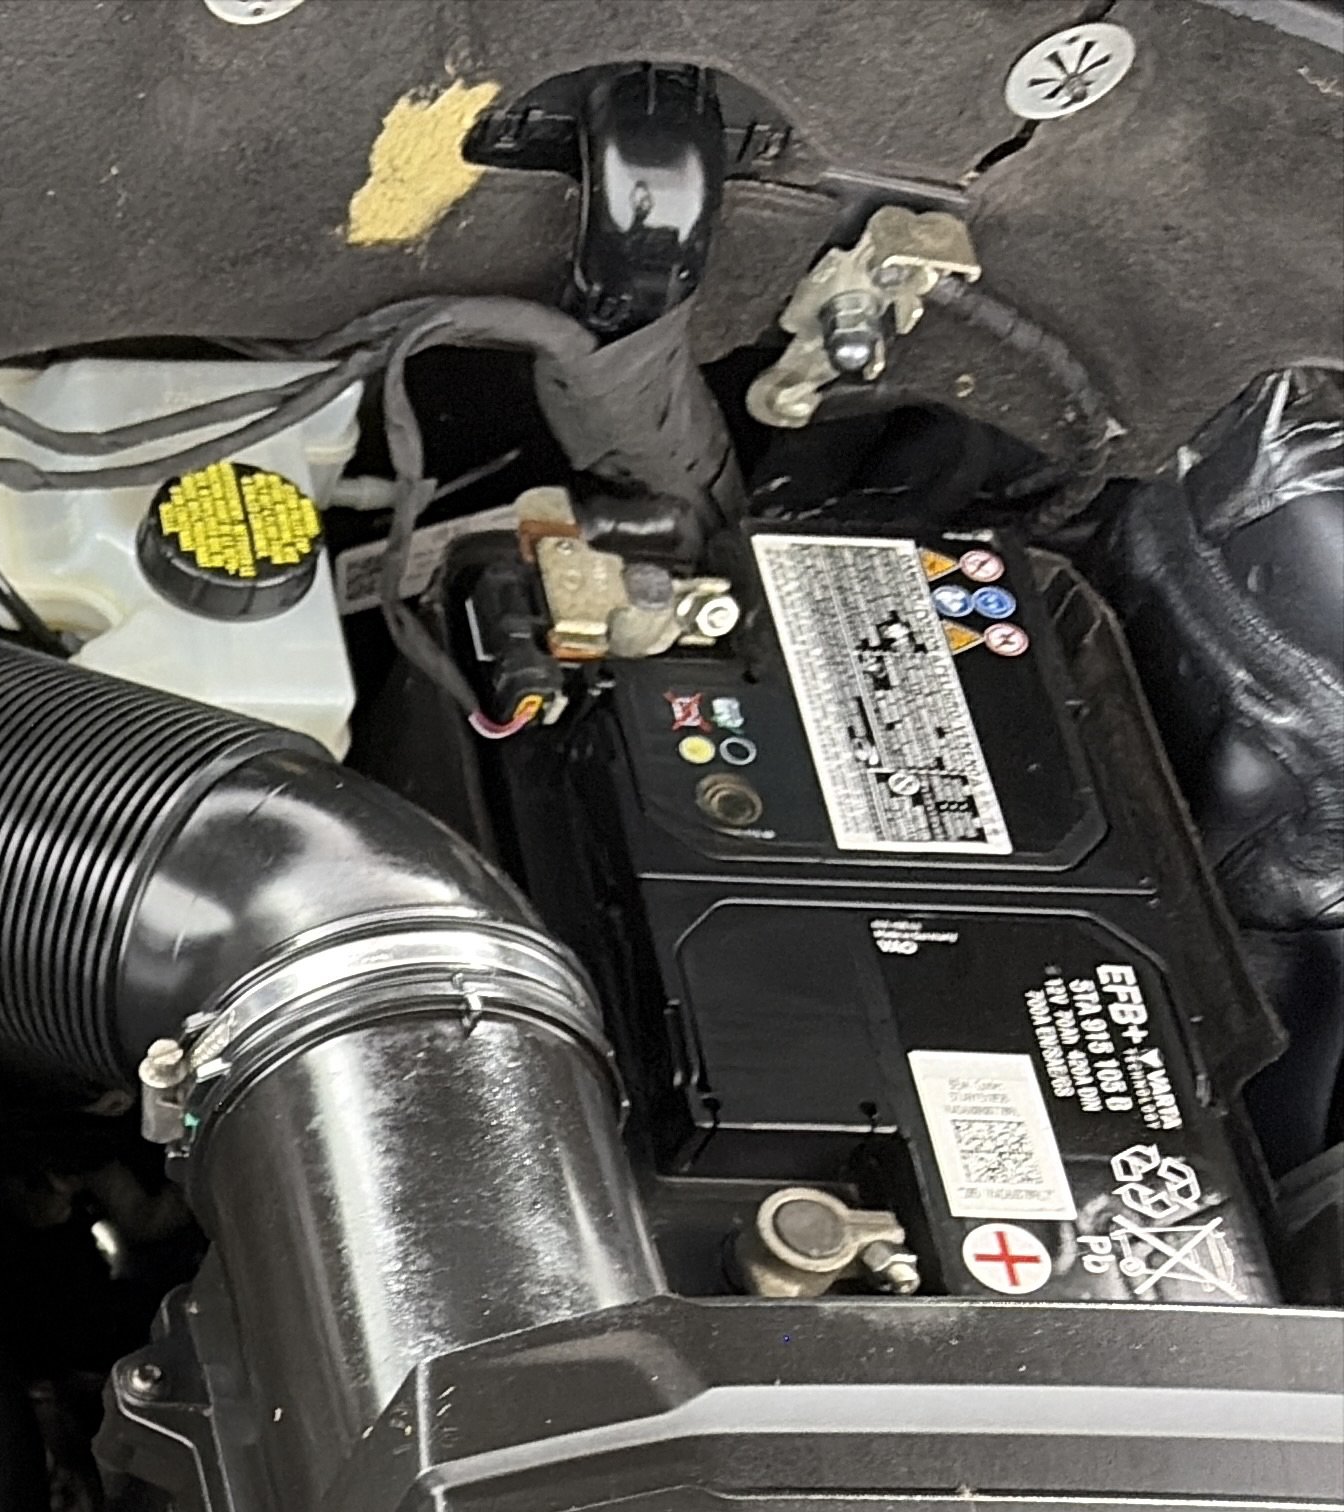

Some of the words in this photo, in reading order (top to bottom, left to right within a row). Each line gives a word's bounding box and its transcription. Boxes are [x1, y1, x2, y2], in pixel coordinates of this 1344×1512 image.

[1096, 963, 1149, 1044] EFB+
[1044, 977, 1070, 1005] 12V
[1076, 1086, 1104, 1112] DIN
[1080, 1018, 1115, 1054] 915
[1093, 1058, 1128, 1093] 105
[1146, 1068, 1183, 1130] VARTA
[1076, 1235, 1116, 1274] Pb
